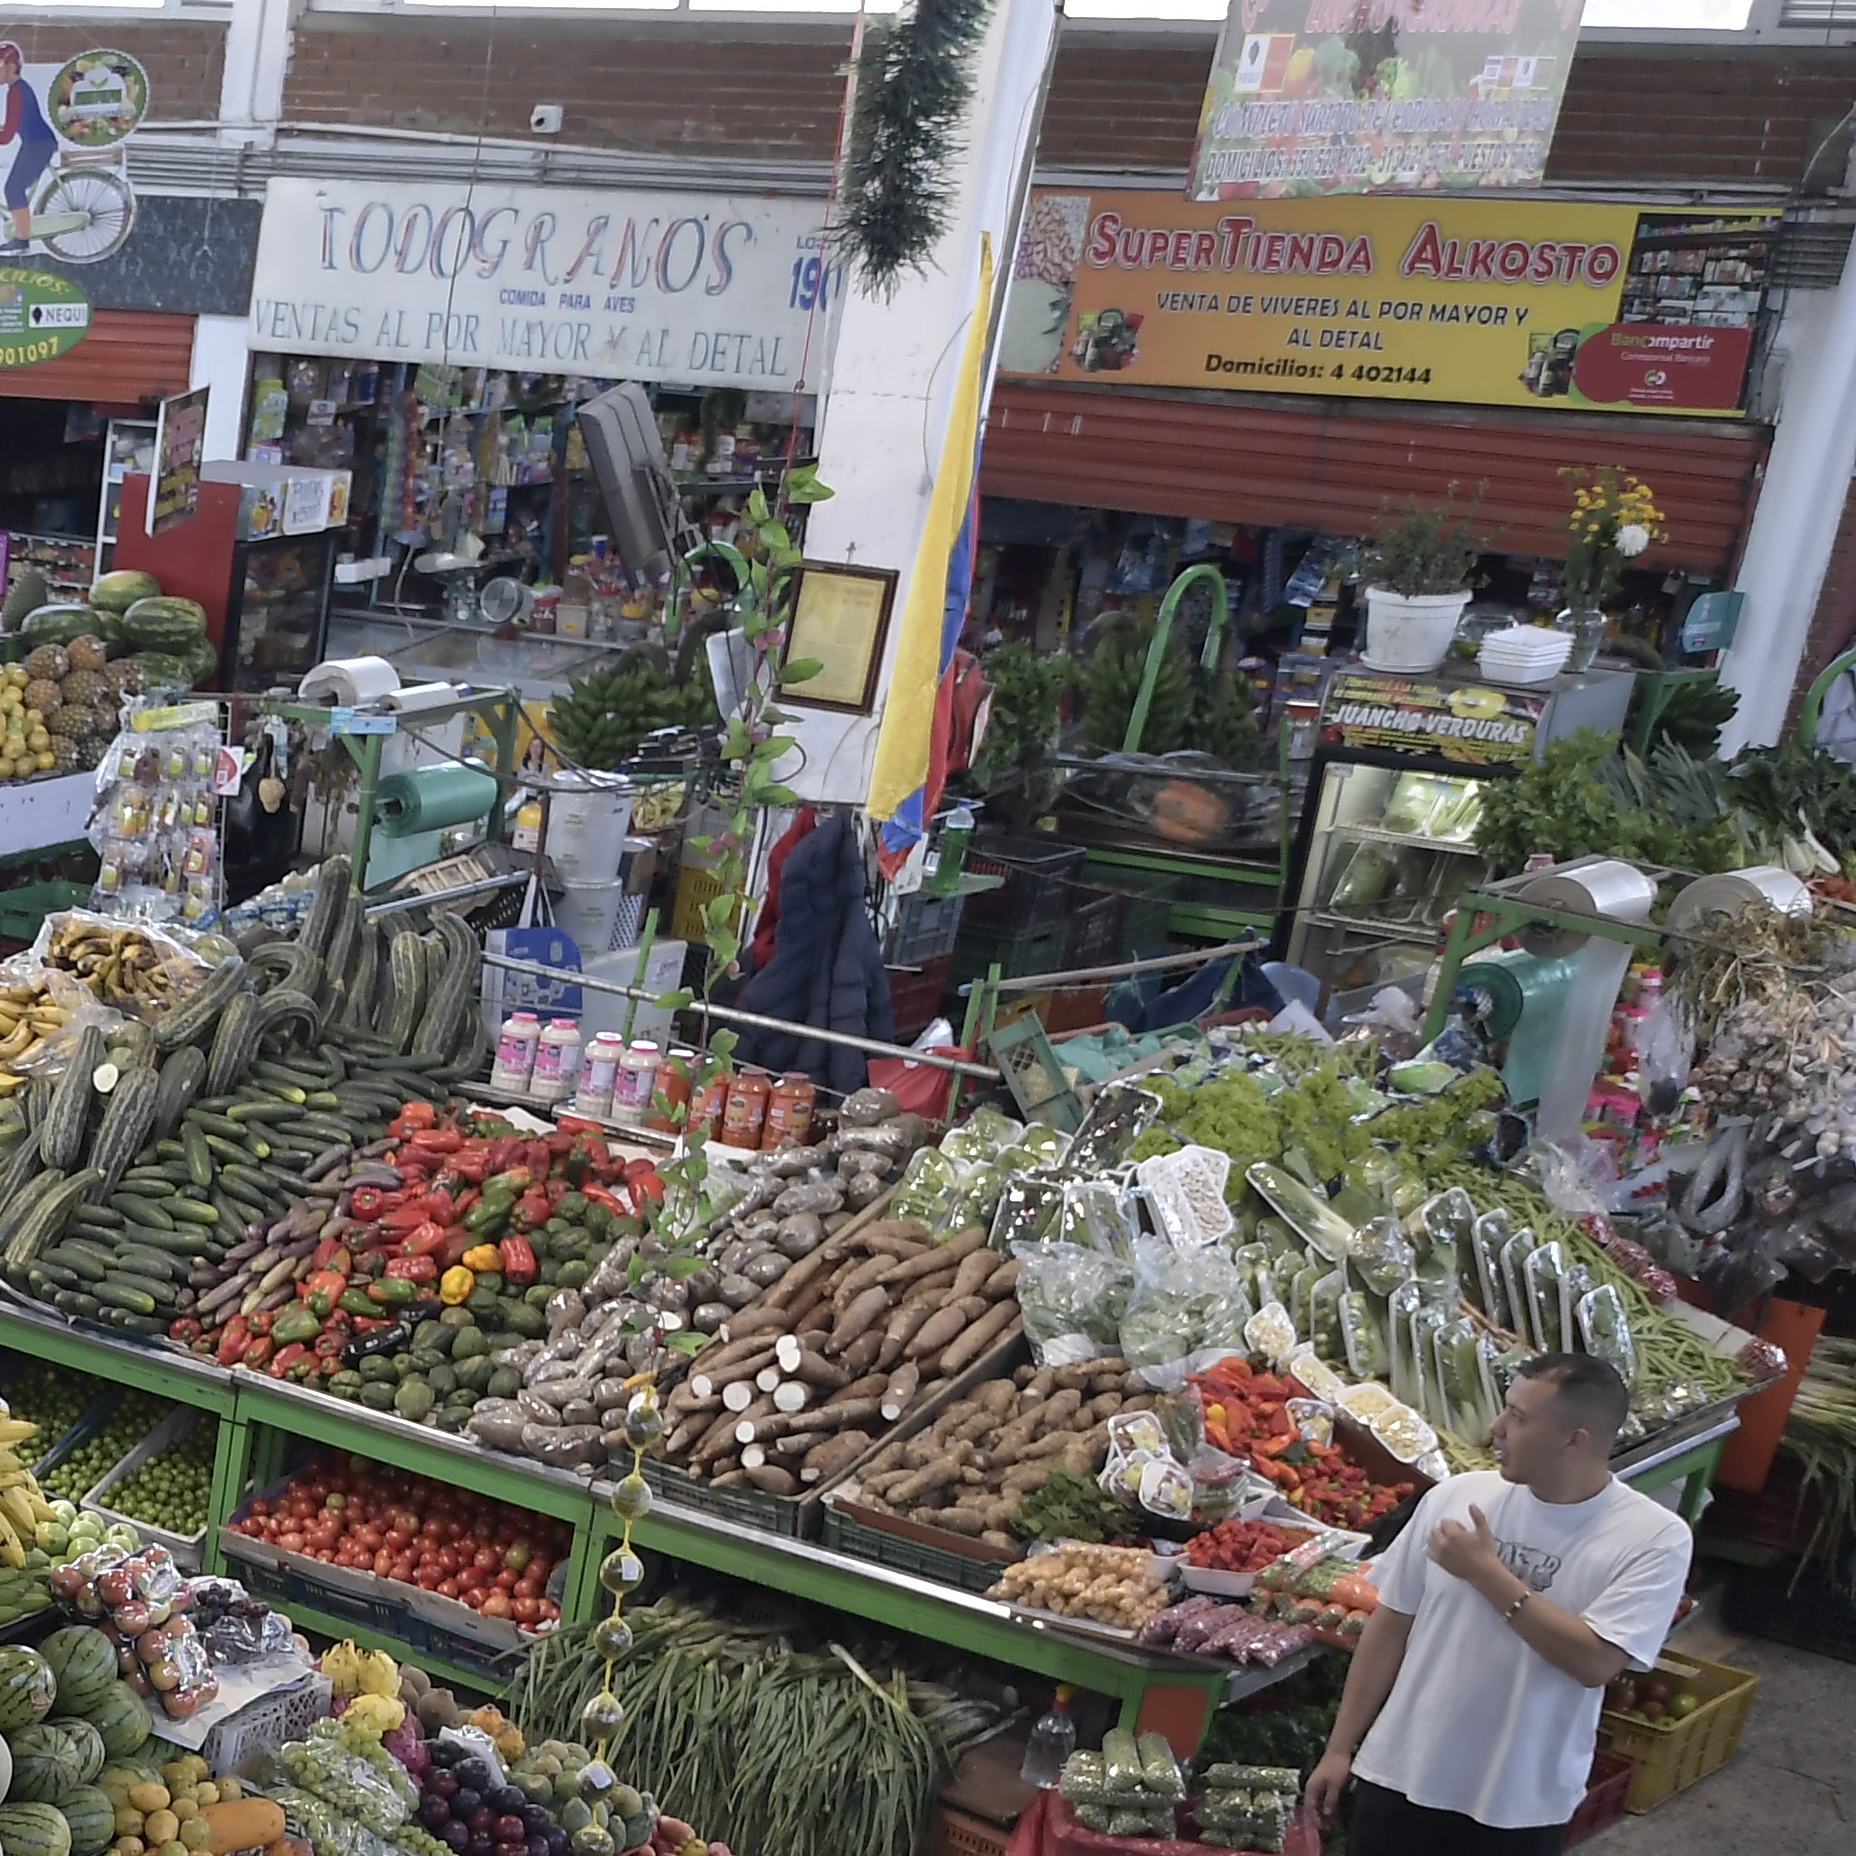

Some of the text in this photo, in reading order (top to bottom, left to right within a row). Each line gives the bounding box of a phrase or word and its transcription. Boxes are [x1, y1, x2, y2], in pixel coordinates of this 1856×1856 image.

[319, 200, 754, 297] TODOGRANOS
[1400, 220, 1622, 289] ALKOSTO
[45, 309, 86, 322] NEQUI
[499, 288, 636, 314] COMIDA PARA AVES
[1156, 292, 1529, 325] VENTA DE VIVERES AL POR MAYOR Y
[253, 300, 787, 377] VENTAS AL POR MAYOR Y AL DETAL
[1286, 328, 1384, 351] AL DETAL
[1204, 354, 1433, 385] Domicilios: 4 402144
[1332, 704, 1423, 732] JUANCHO
[1424, 713, 1529, 744] VERDURAS
